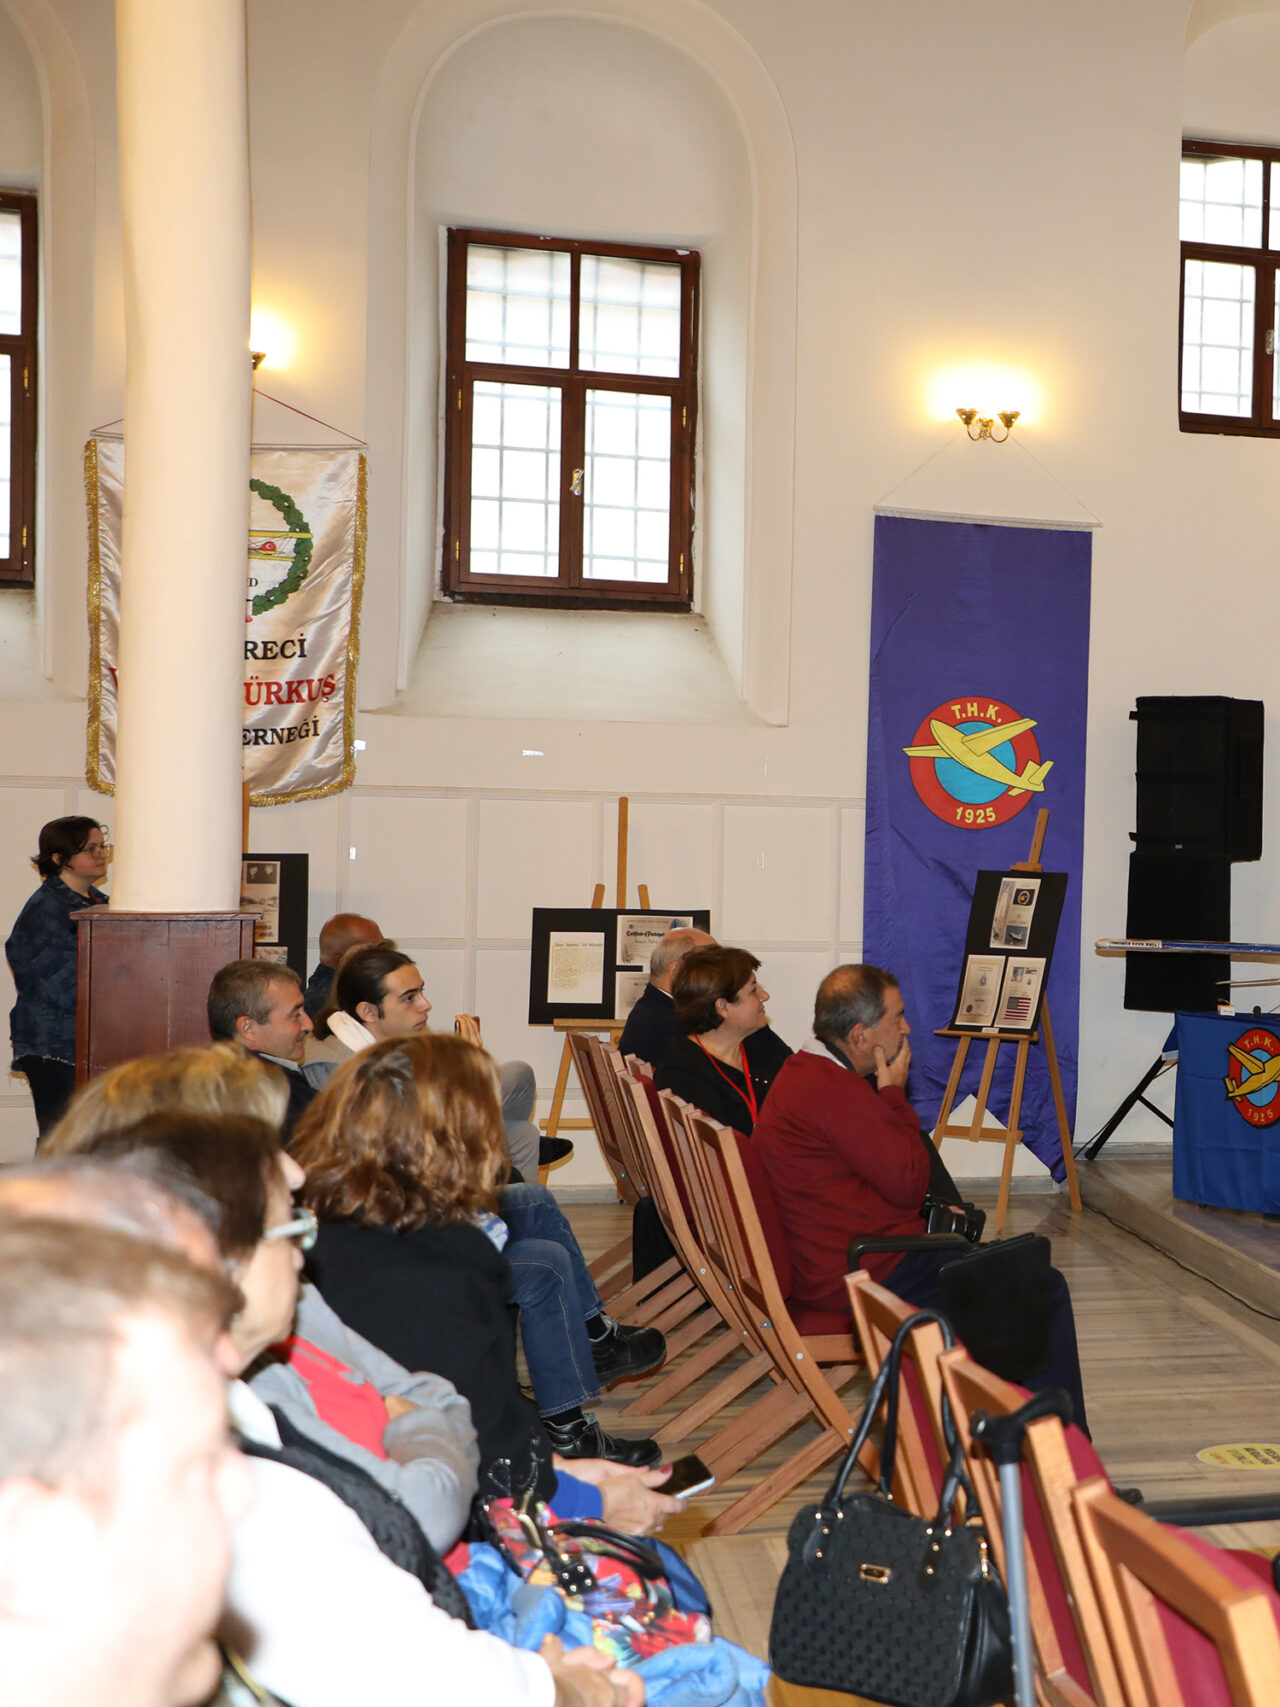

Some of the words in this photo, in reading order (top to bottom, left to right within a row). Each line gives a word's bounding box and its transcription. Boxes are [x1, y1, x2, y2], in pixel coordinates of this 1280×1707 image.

[244, 633, 307, 659] RECİ
[244, 673, 336, 706] ÜRKUŞ
[242, 716, 320, 746] ERNEĞİ
[955, 806, 996, 824] 1925
[1247, 1108, 1274, 1122] 1925
